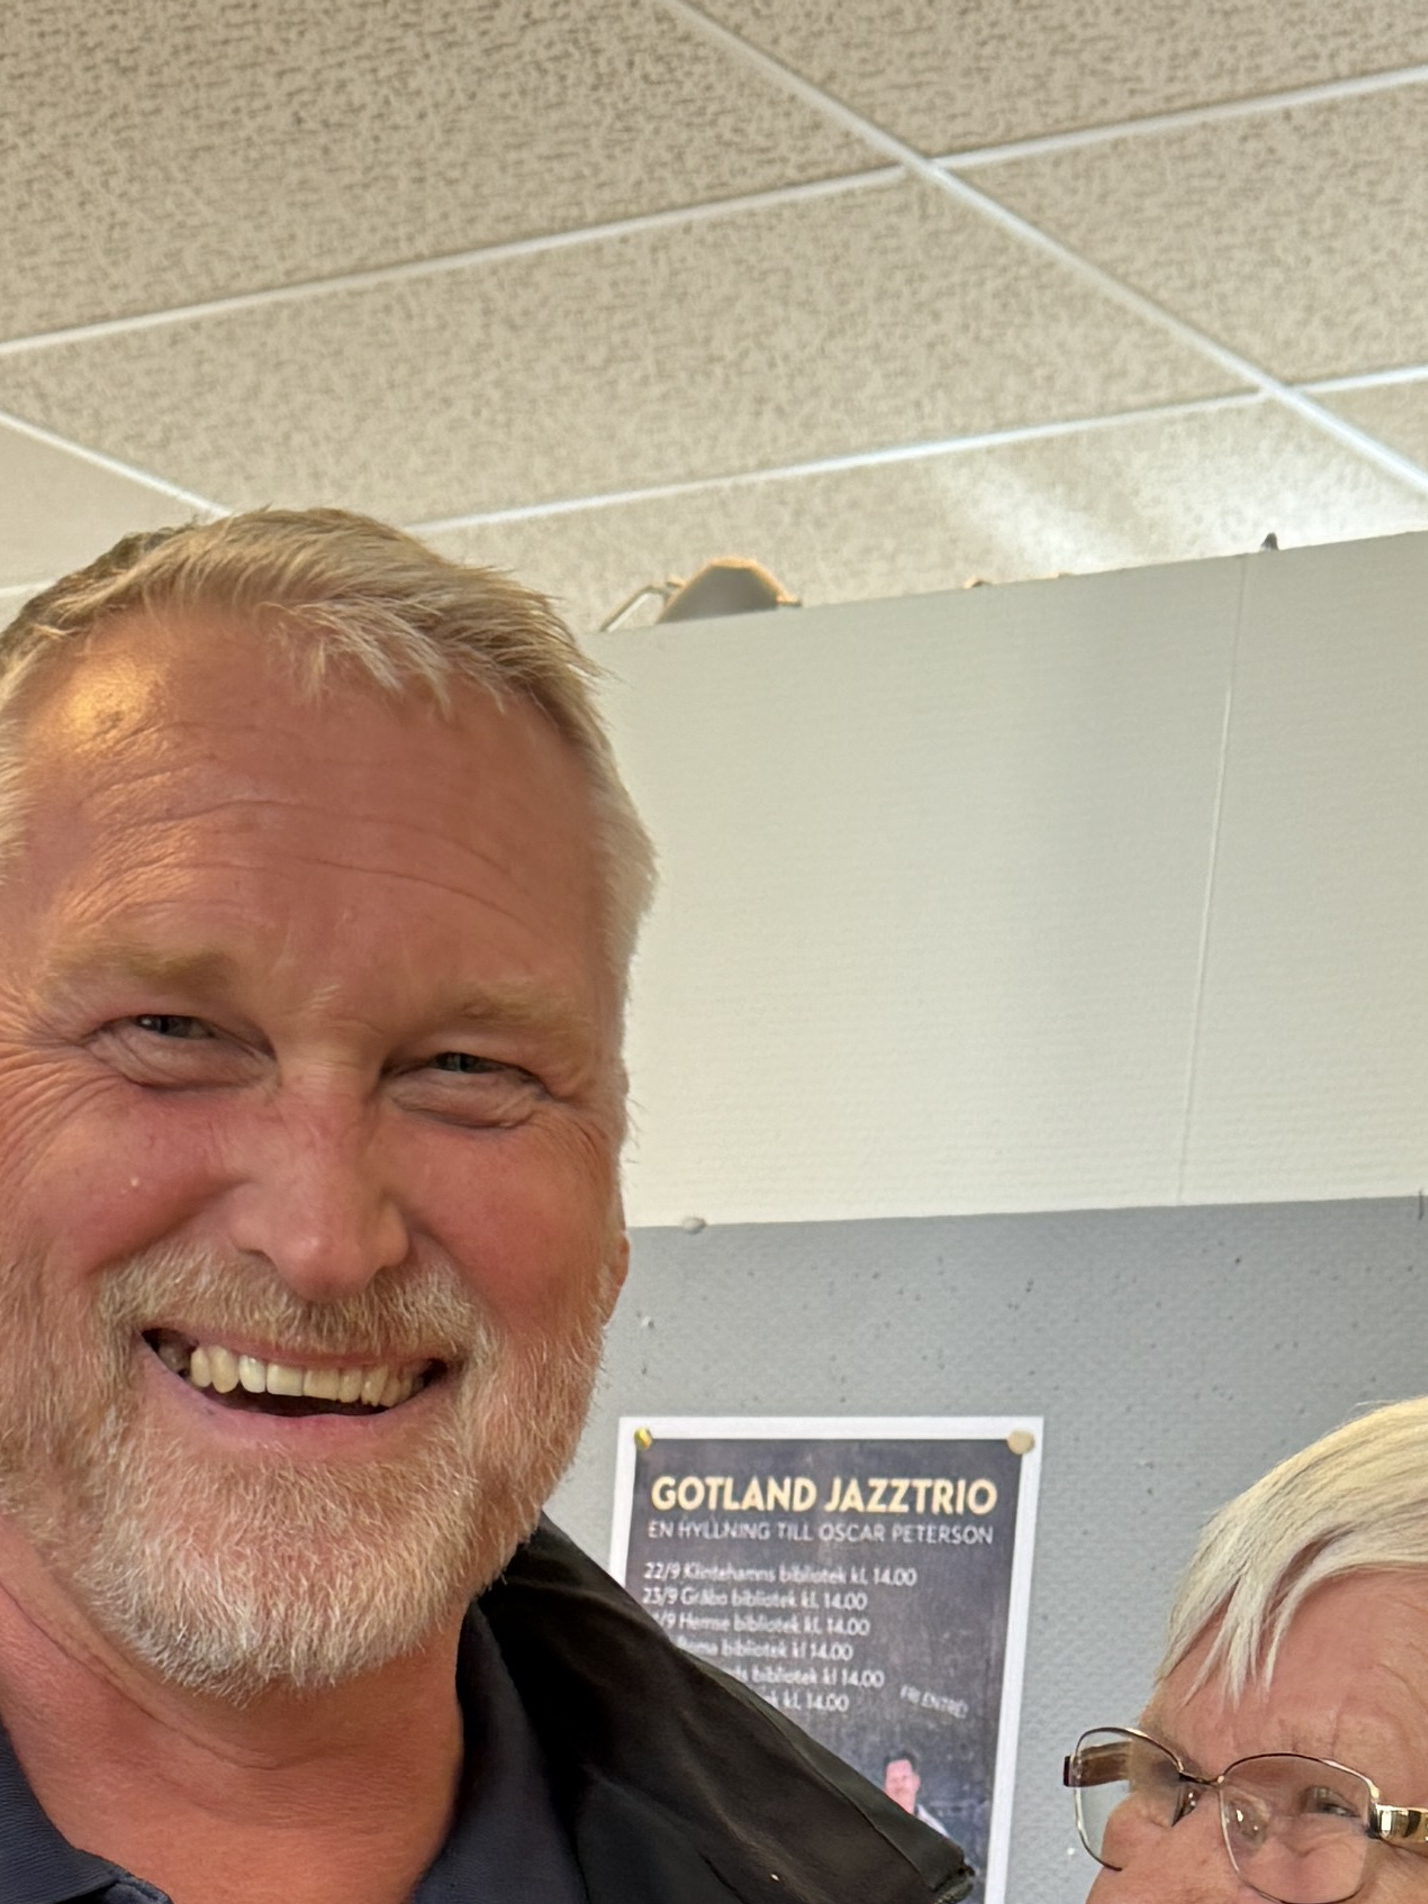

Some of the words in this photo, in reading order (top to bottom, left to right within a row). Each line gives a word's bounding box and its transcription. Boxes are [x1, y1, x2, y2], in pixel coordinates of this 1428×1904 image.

[651, 1475, 817, 1512] GOTLAND
[824, 1476, 998, 1515] JAZZTRIO
[648, 1520, 673, 1538] EN
[678, 1520, 770, 1540] HYLLNING
[777, 1521, 814, 1541] TILL
[819, 1523, 885, 1542] OSCAR
[892, 1524, 994, 1544] PETERSON
[643, 1561, 681, 1581] 22/9
[779, 1562, 847, 1584] bibliotek
[873, 1567, 918, 1587] 14.00
[642, 1586, 679, 1606] 23/9
[731, 1587, 798, 1608] bibliotek
[824, 1591, 869, 1611] 14.00
[733, 1612, 801, 1633] bibliotek
[826, 1616, 871, 1636] 14.00
[722, 1637, 787, 1658] bibliotek
[810, 1641, 854, 1661] 14.00
[752, 1663, 818, 1685] bibliotek
[841, 1668, 886, 1688] 14.00
[806, 1691, 850, 1711] 14.00
